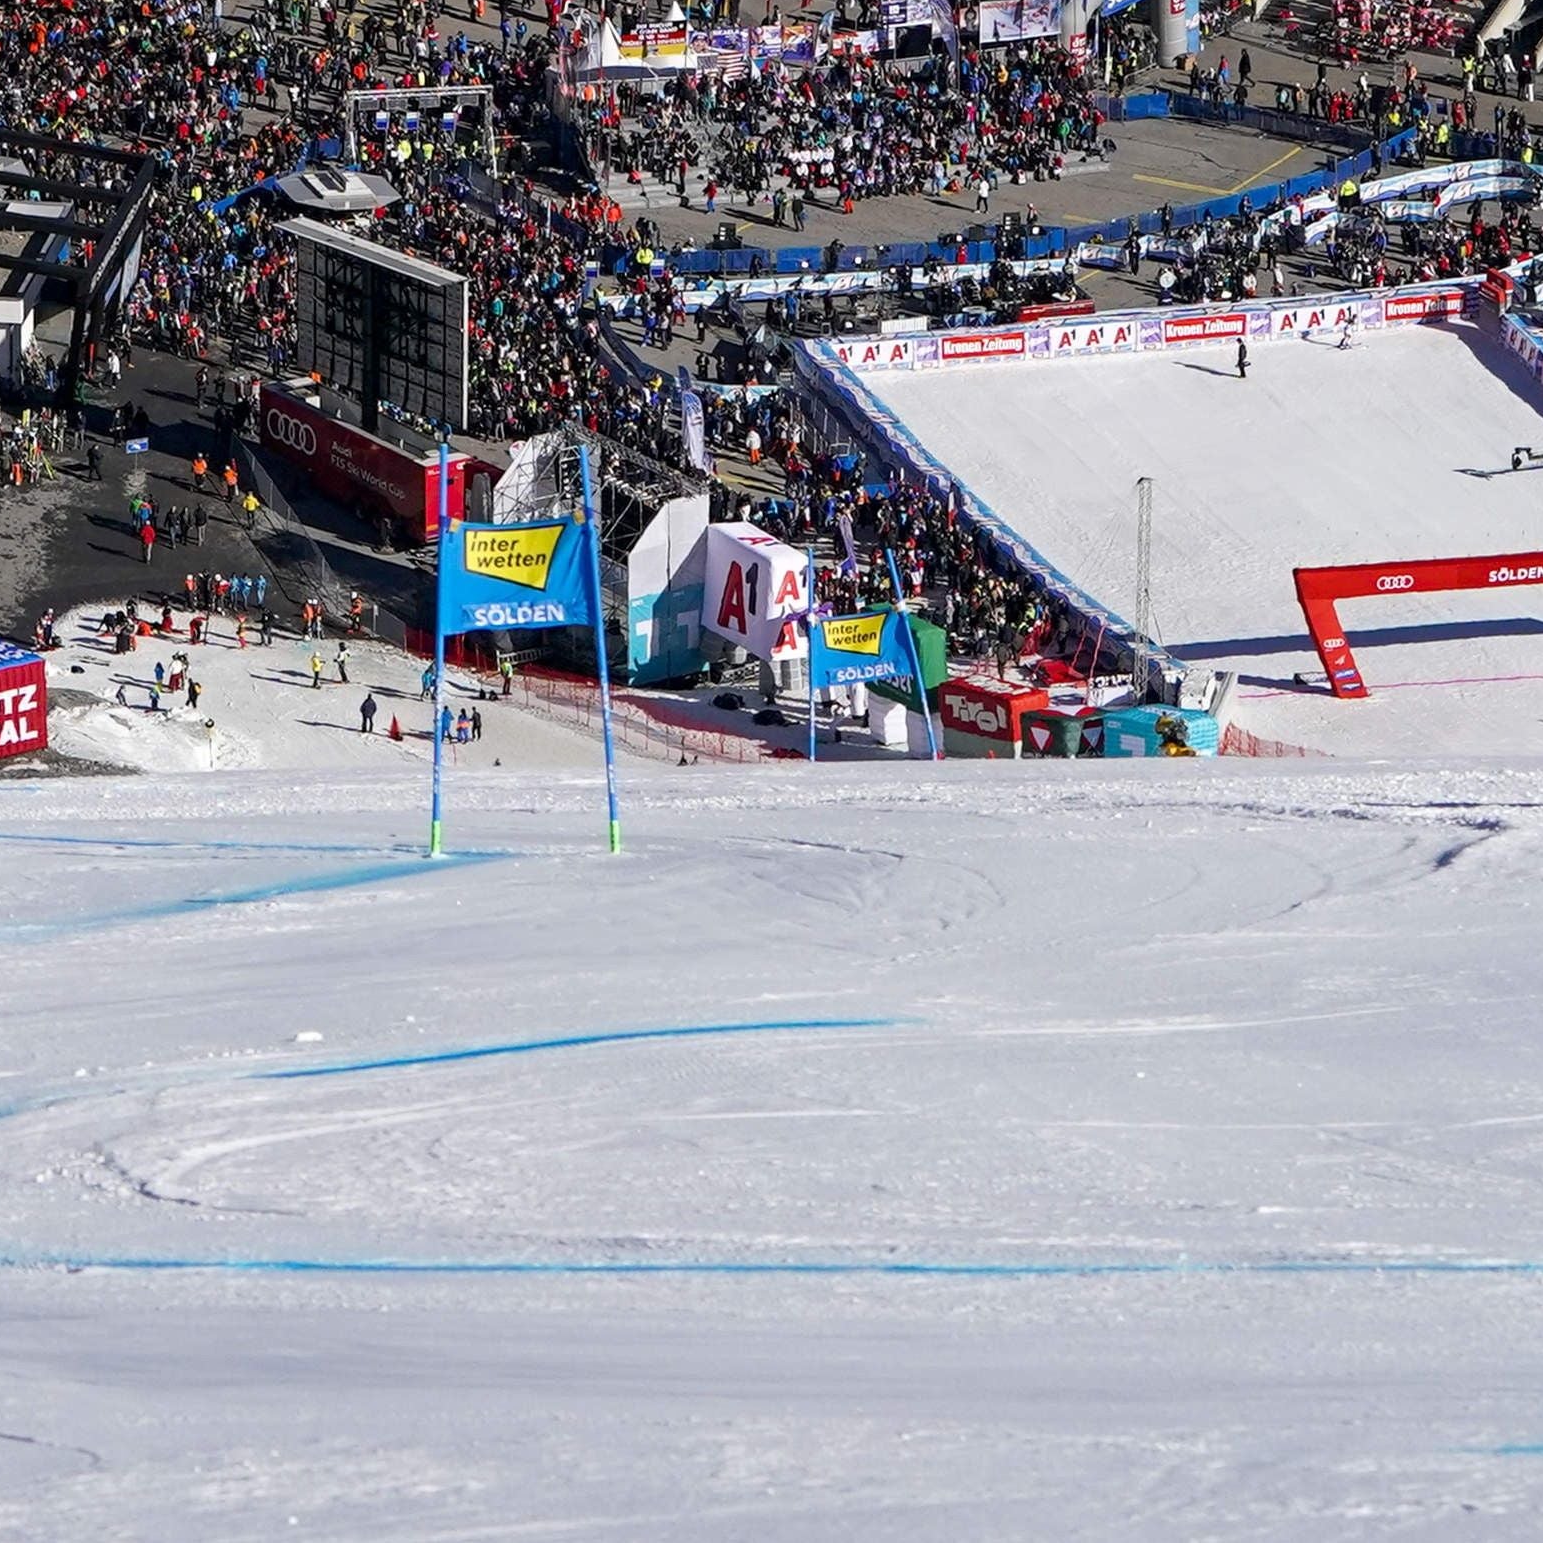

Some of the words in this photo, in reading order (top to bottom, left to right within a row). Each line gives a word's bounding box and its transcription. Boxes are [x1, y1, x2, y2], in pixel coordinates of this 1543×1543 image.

[1387, 301, 1423, 317] Kronen
[1167, 323, 1204, 338] Kronen
[1205, 318, 1244, 335] Zeitung
[943, 339, 982, 355] Kronen
[982, 335, 1023, 353] Zeitung
[331, 440, 353, 458] Audi
[330, 454, 346, 471] FIS
[361, 469, 388, 490] World
[388, 483, 406, 500] Cup
[471, 531, 520, 552] inter
[477, 552, 547, 568] wetten
[717, 560, 759, 635] A1
[474, 603, 565, 627] SÖLDEN
[828, 621, 860, 636] inter
[833, 630, 878, 646] wetten
[836, 662, 896, 683] SÖLDEN
[944, 694, 1007, 732] Tirol
